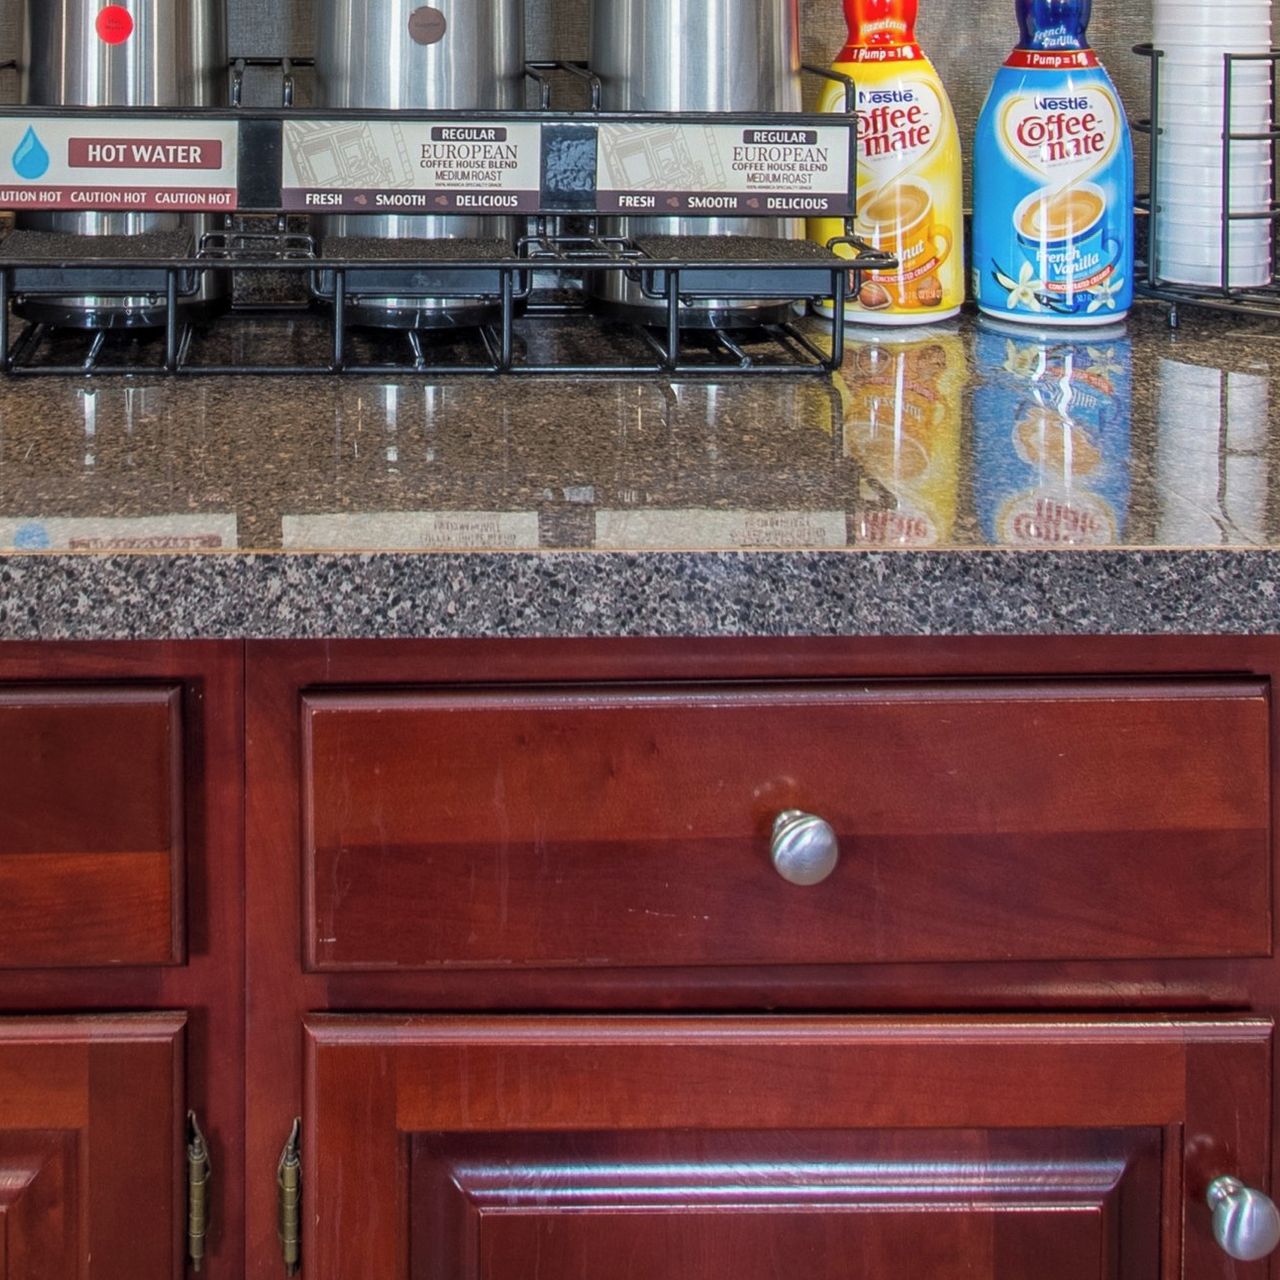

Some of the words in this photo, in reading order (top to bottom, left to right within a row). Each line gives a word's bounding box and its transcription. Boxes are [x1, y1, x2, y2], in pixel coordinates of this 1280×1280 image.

[858, 49, 886, 62] Pump
[1026, 54, 1031, 64] 1
[1033, 54, 1061, 68] Pump
[856, 105, 929, 140] offee-
[442, 128, 496, 140] REGULAR
[753, 131, 806, 143] REGULAR
[865, 125, 931, 157] mate
[88, 144, 127, 162] HOT
[131, 145, 201, 163] WATER
[421, 143, 519, 160] EUROPEAN
[733, 146, 829, 163] EUROPEAN
[1040, 132, 1105, 163] mate
[420, 159, 453, 169] COFFEE
[456, 160, 486, 169] HOUSE
[488, 160, 518, 170] BLEND
[732, 162, 765, 171] COFFEE
[767, 162, 797, 172] HOUSE
[799, 163, 828, 172] BLEND
[435, 170, 470, 181] MEDIUM
[471, 170, 503, 181] ROAST
[746, 173, 780, 183] MEDIUM
[782, 173, 813, 184] ROAST
[40, 191, 62, 202] HOT
[70, 191, 121, 203] CAUTION
[124, 192, 147, 203] HOT
[155, 192, 206, 204] CAUTION
[208, 193, 231, 205] HOT
[305, 193, 342, 205] FRESH
[375, 194, 426, 206] SMOOTH
[456, 195, 518, 207] DELICIOUS
[619, 196, 655, 207] FRESH
[688, 196, 738, 208] SMOOTH
[767, 197, 828, 210] DELICIOUS
